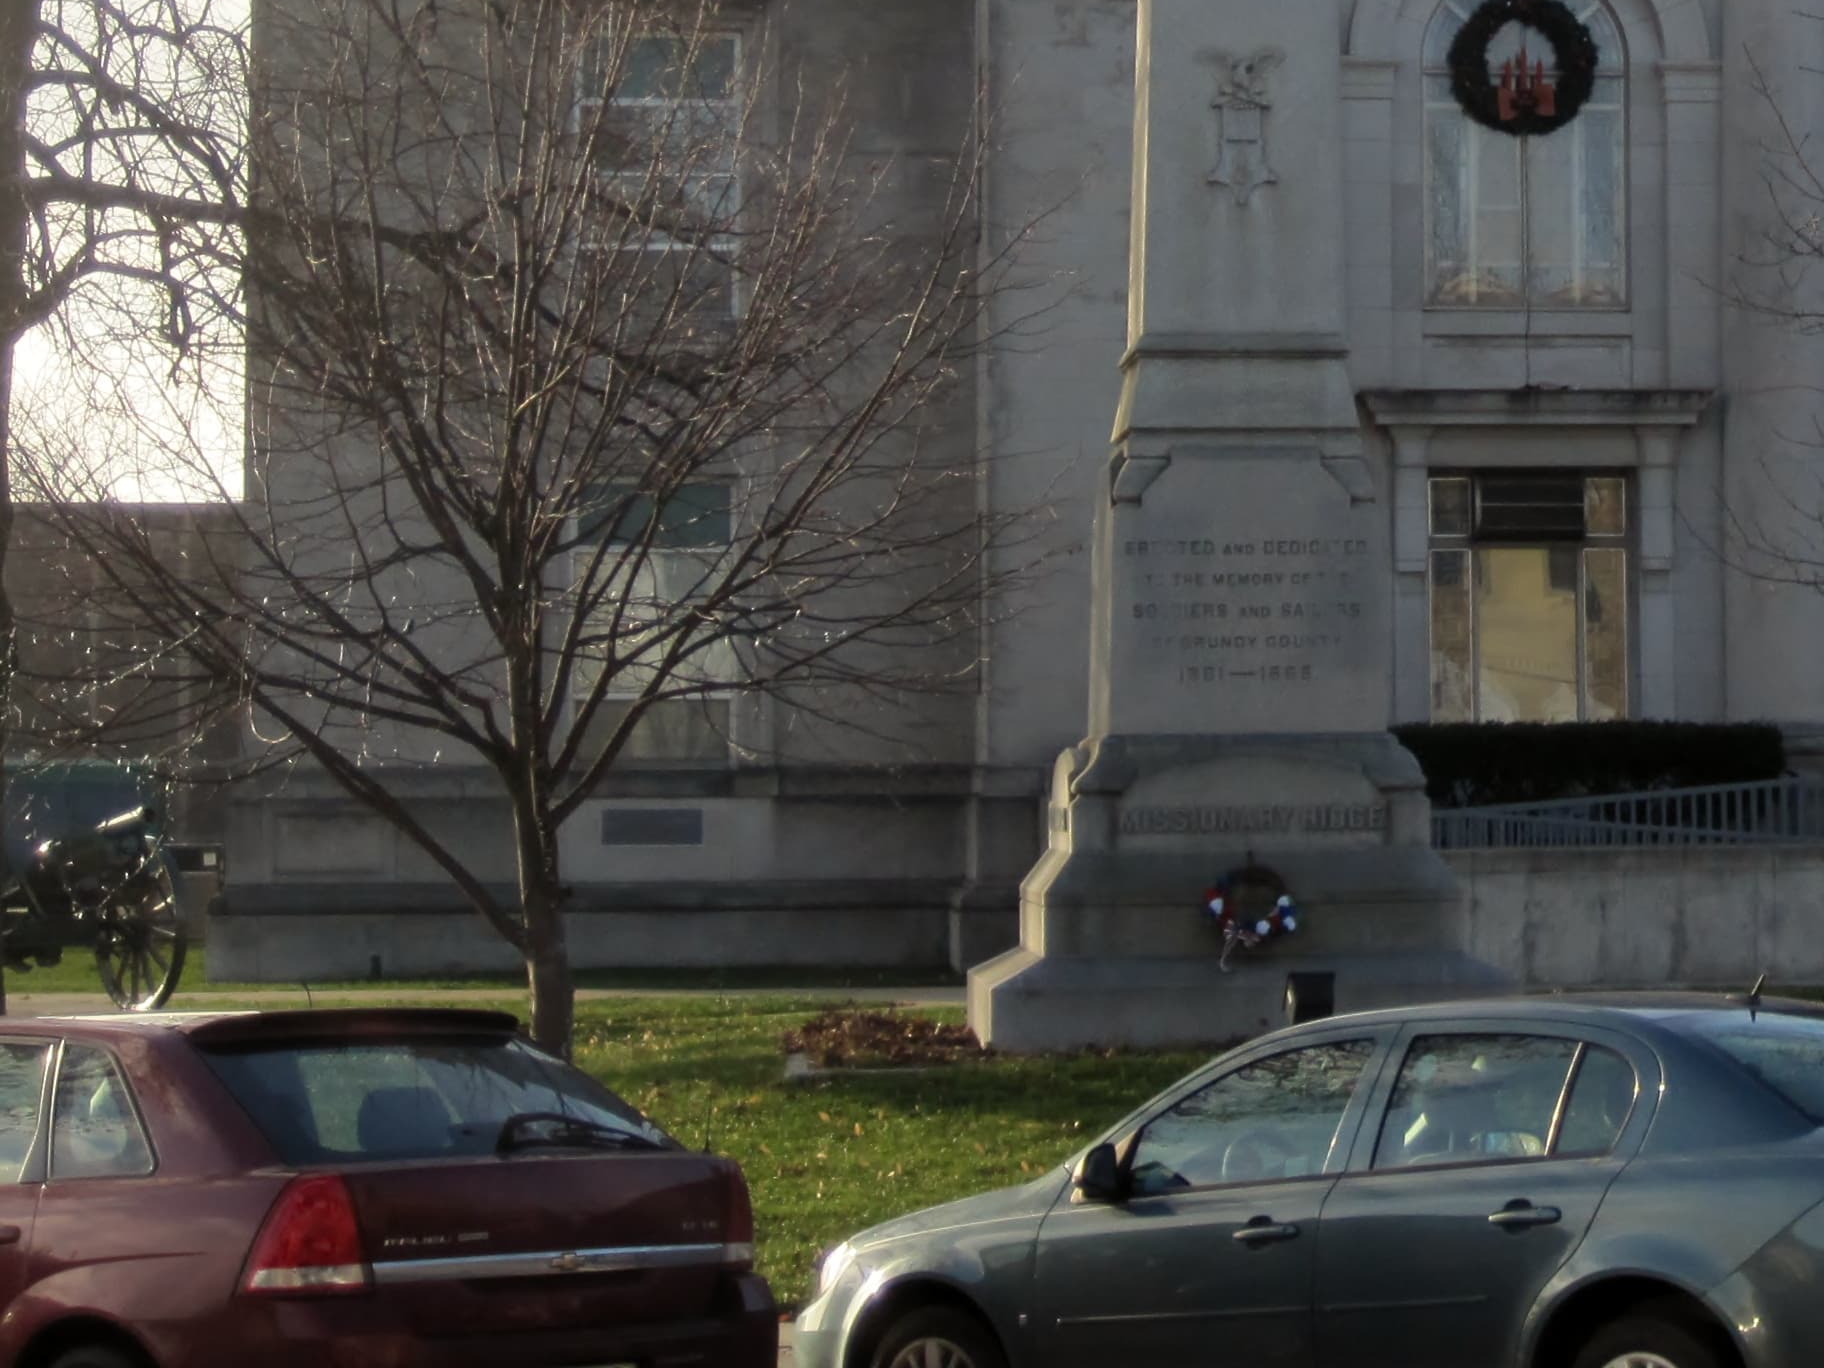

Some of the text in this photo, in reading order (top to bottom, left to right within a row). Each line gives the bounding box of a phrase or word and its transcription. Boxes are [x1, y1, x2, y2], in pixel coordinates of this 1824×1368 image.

[1124, 539, 1367, 556] ERTED AND DEDICTED
[1133, 602, 1361, 619] SOIERS AND SARS
[1302, 804, 1389, 832] RIDGE
